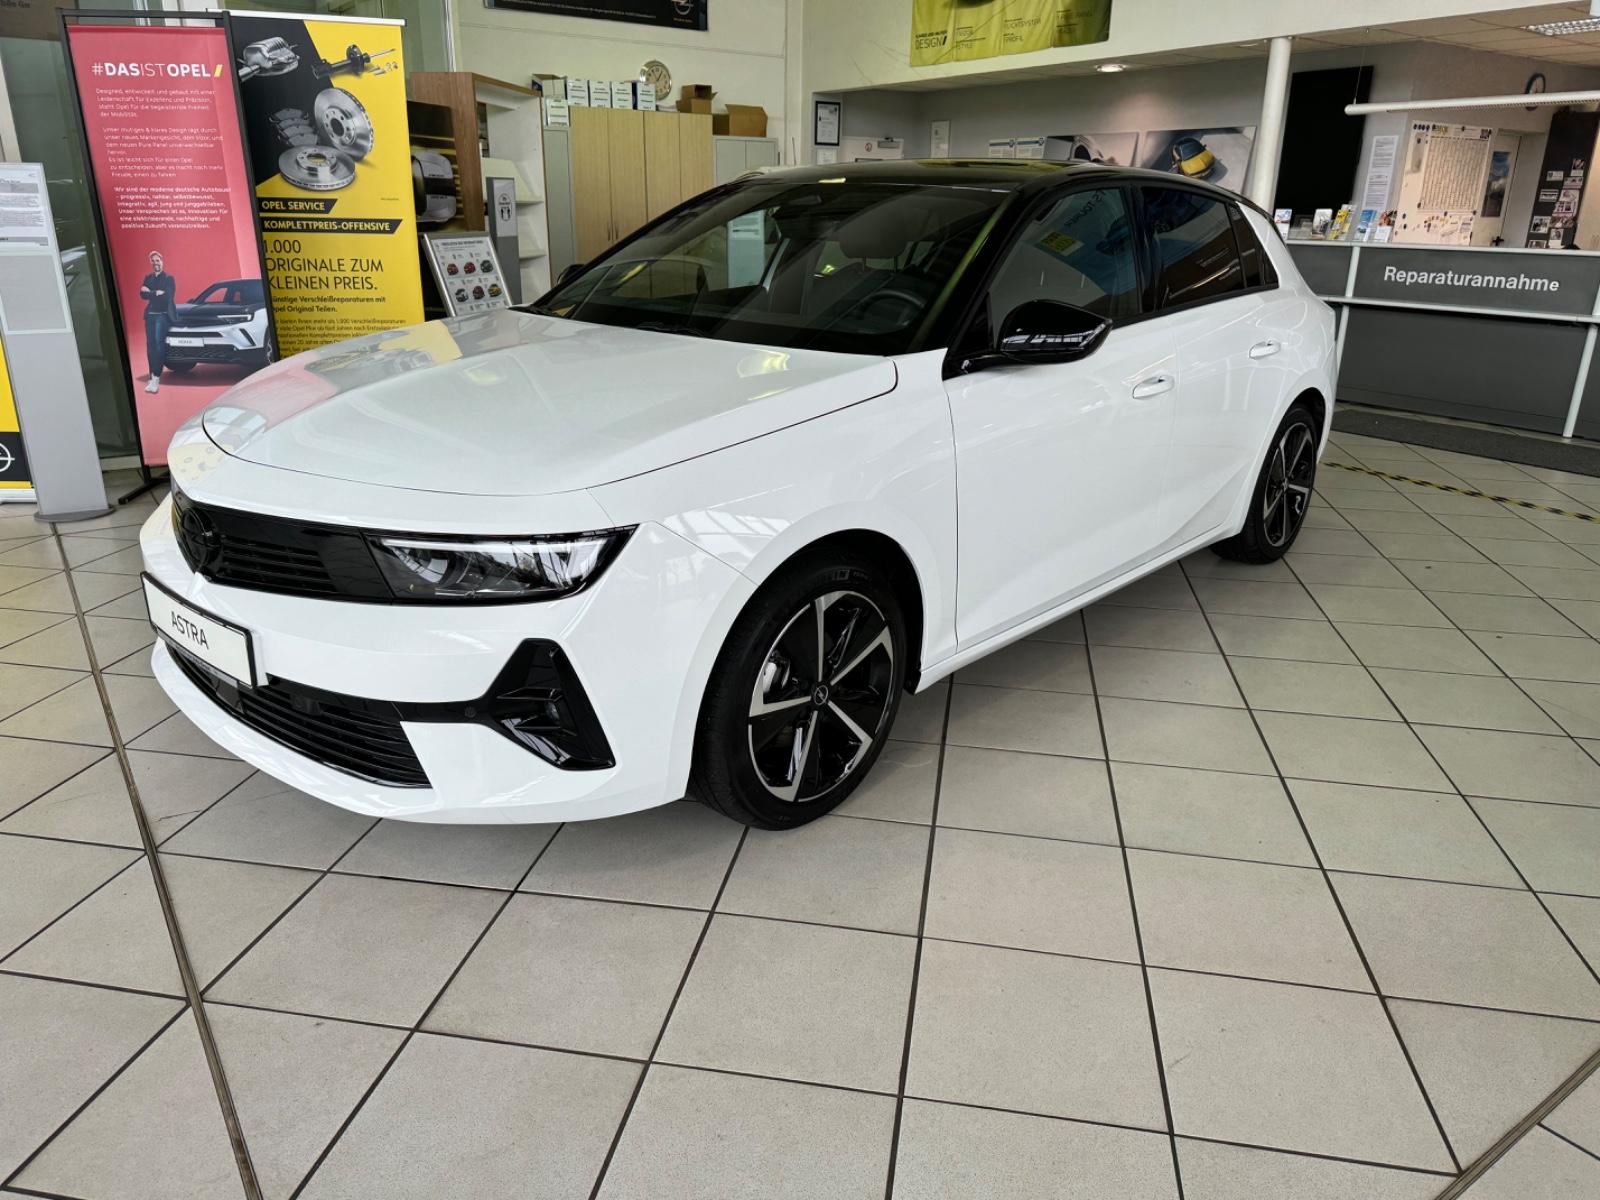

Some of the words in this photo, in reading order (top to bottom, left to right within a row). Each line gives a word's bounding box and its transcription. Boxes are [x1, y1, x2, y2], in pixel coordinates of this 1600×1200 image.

[915, 35, 943, 50] DESIGN
[92, 62, 211, 77] #DASISTOPEL
[261, 200, 285, 210] OPEL
[287, 200, 325, 211] SERVICE
[264, 220, 391, 231] KOMPLETTPREIS-OFFENSIVE
[266, 257, 345, 273] ORIGINALE
[350, 257, 384, 273] ZUM
[267, 275, 329, 290] KLEINEN
[334, 275, 378, 290] PREIS.
[1384, 266, 1560, 292] Reparaturannahme
[272, 295, 298, 304] ünstige
[299, 295, 375, 304] Verschleißreparaturen
[375, 295, 386, 304] mit
[287, 305, 315, 314] Original
[315, 305, 338, 313] Teilen.
[171, 611, 209, 650] ASTRA
